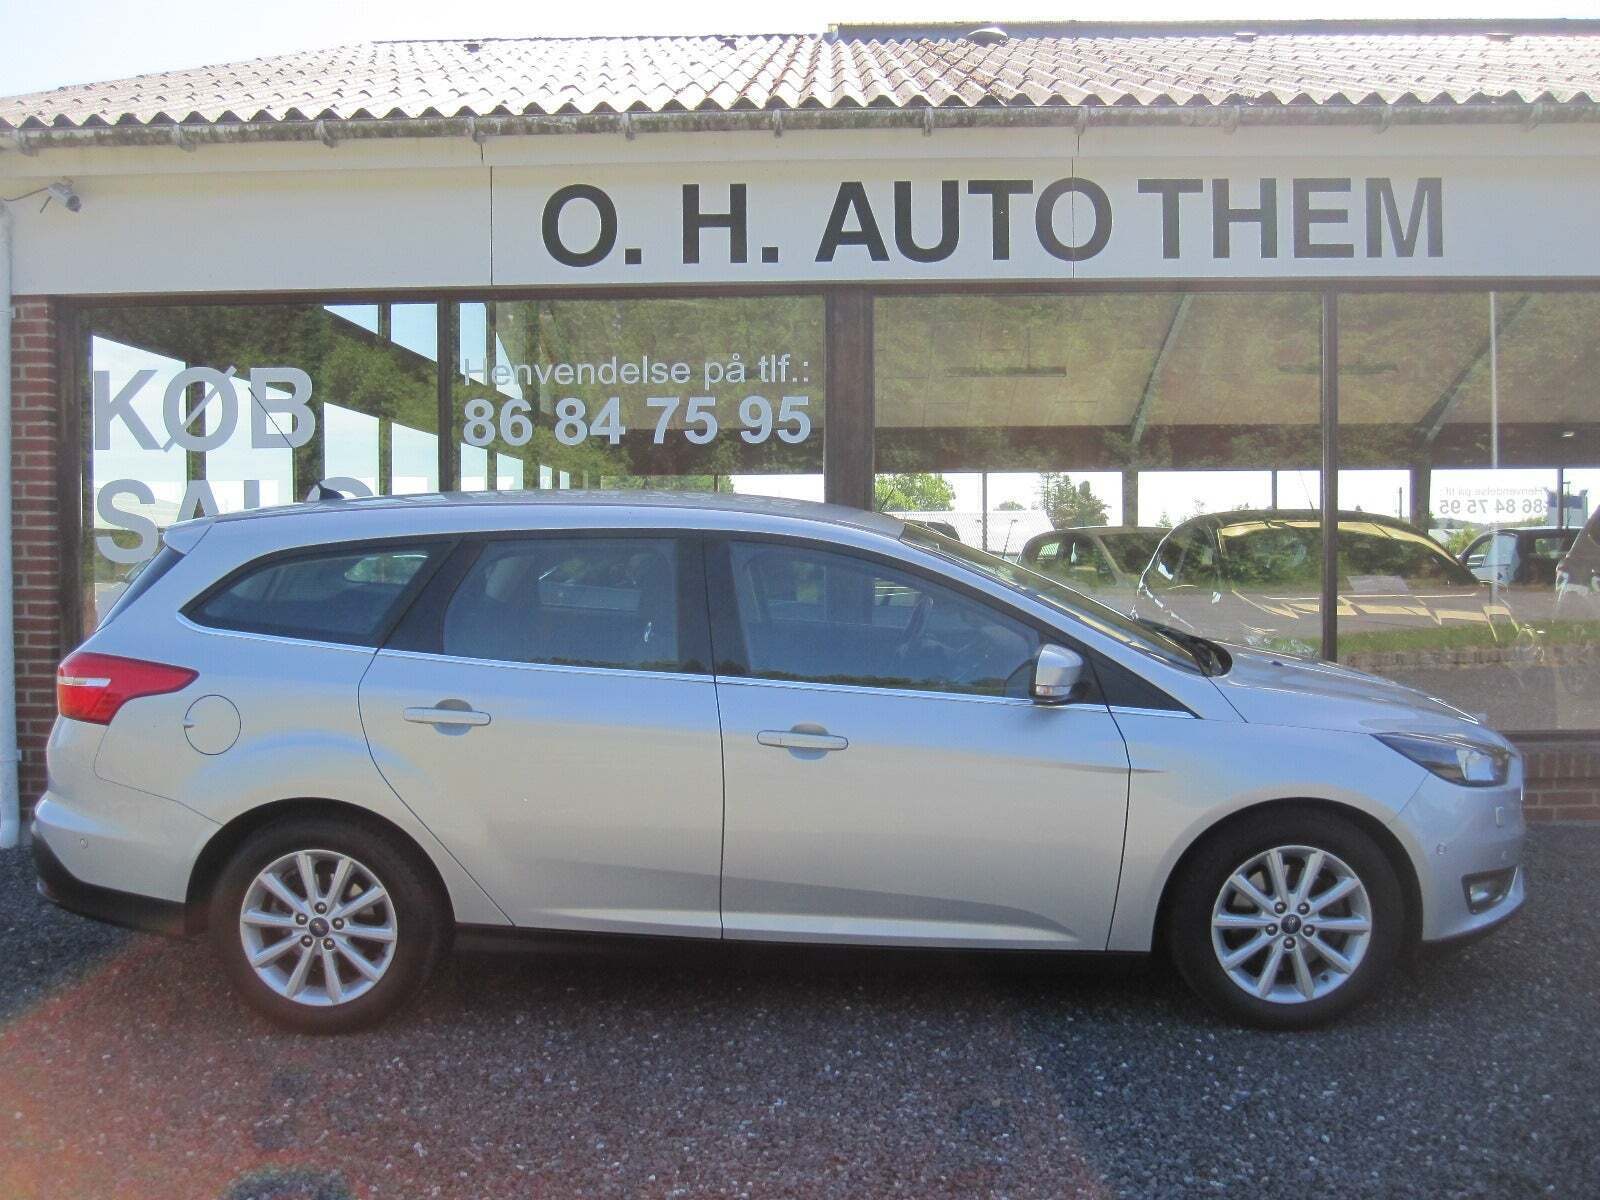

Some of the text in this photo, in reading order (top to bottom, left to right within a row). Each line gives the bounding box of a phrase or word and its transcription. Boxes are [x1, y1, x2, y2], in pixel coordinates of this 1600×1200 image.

[541, 177, 1444, 267] O. H. AUTO THEM
[463, 356, 691, 386] Henvendelse
[704, 353, 746, 390] på
[94, 365, 316, 452] KØB
[463, 395, 811, 447] 86 84 75 95
